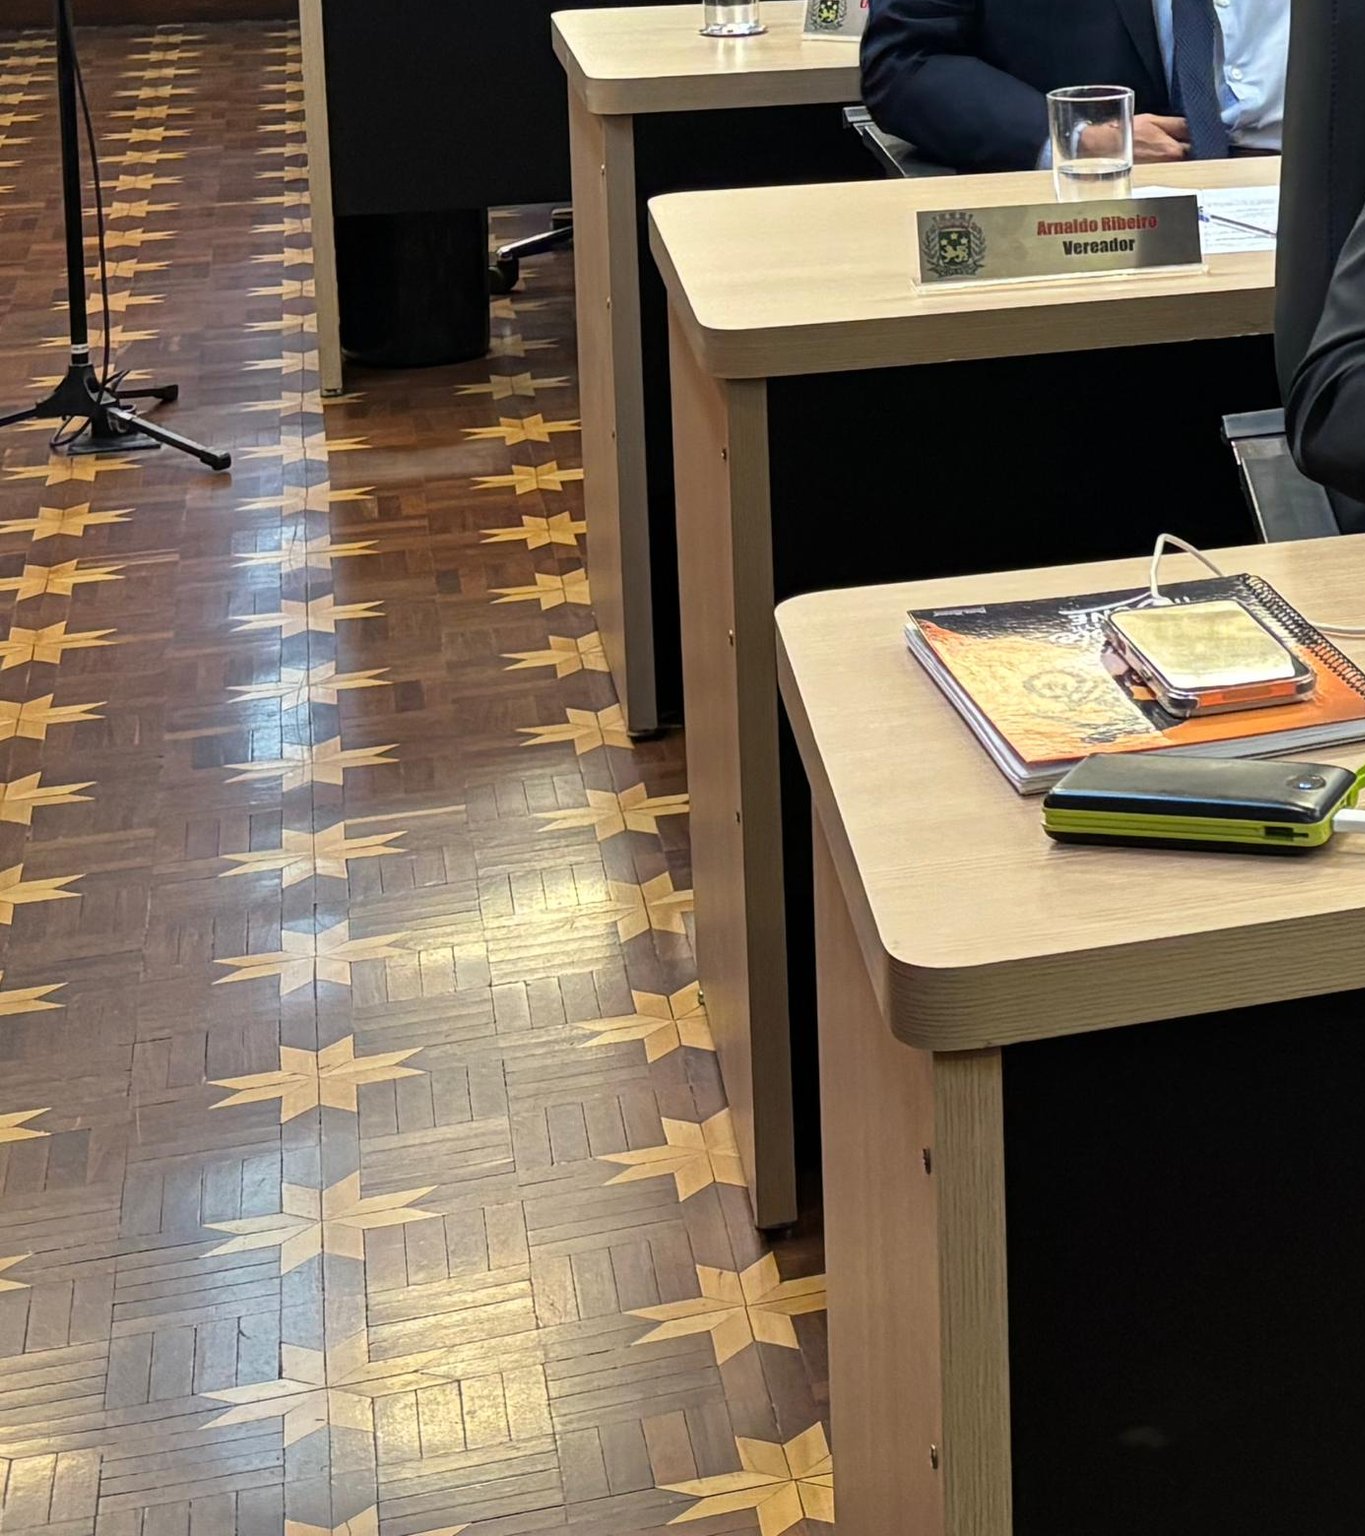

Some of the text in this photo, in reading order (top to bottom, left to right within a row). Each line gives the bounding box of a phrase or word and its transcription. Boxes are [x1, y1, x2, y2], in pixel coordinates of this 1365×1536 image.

[1037, 214, 1157, 236] Arnaldo Ribeiro
[1062, 237, 1135, 255] Vereador
